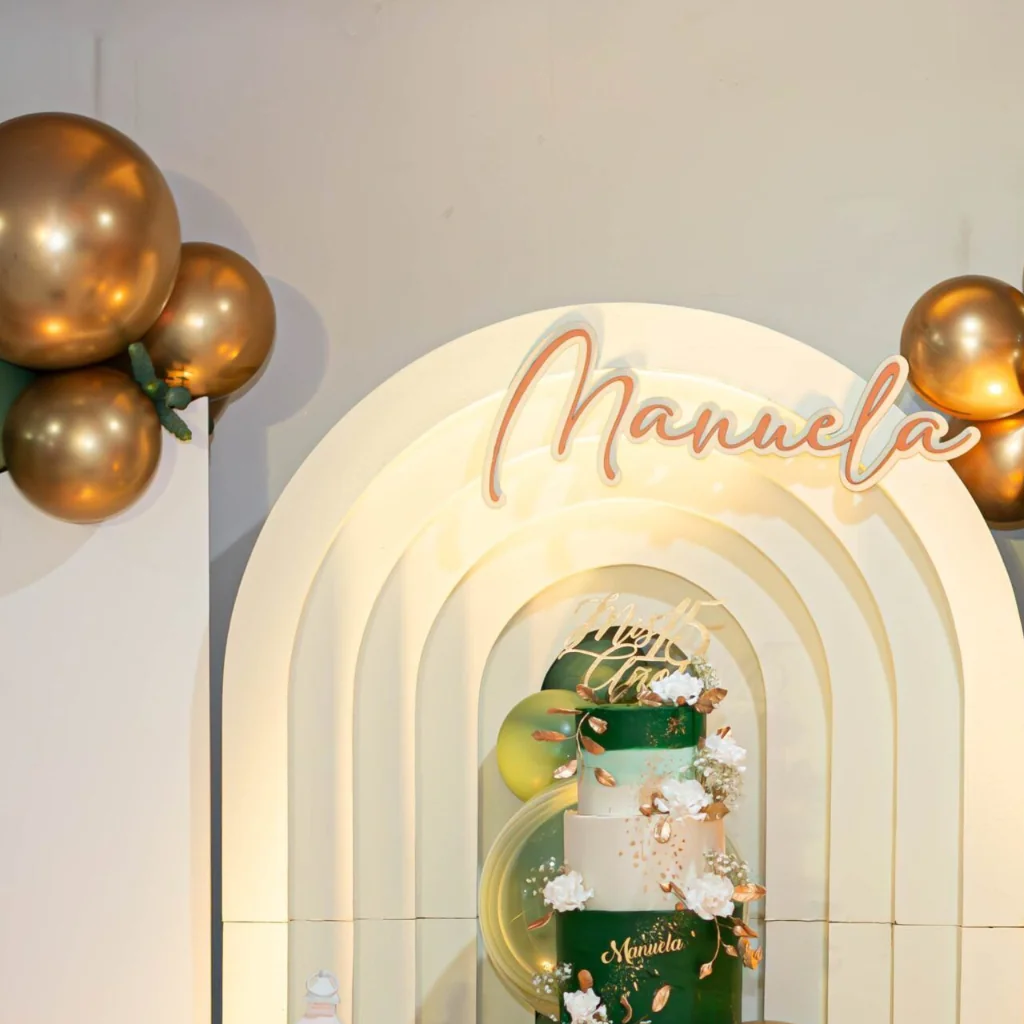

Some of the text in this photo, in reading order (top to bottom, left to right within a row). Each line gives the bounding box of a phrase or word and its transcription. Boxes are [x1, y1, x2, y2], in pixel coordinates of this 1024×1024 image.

[488, 327, 976, 503] Manuela
[564, 592, 726, 667] Mis 15
[601, 932, 684, 965] Manuela
